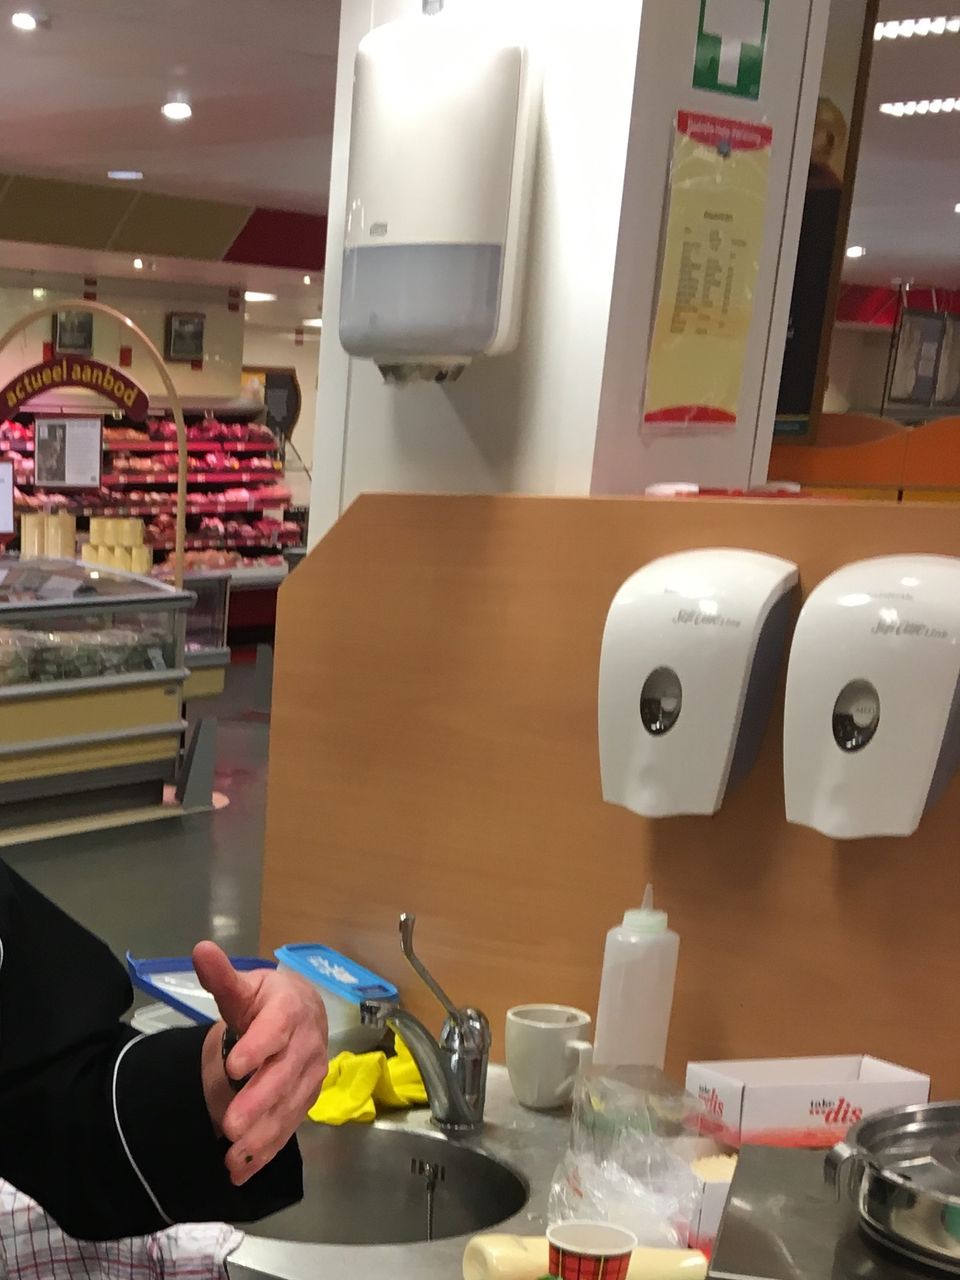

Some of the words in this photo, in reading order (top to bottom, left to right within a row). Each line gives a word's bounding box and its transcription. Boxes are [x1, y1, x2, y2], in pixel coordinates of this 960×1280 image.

[5, 357, 67, 408] actueel
[72, 363, 138, 408] aanbod
[824, 1096, 863, 1124] dis
